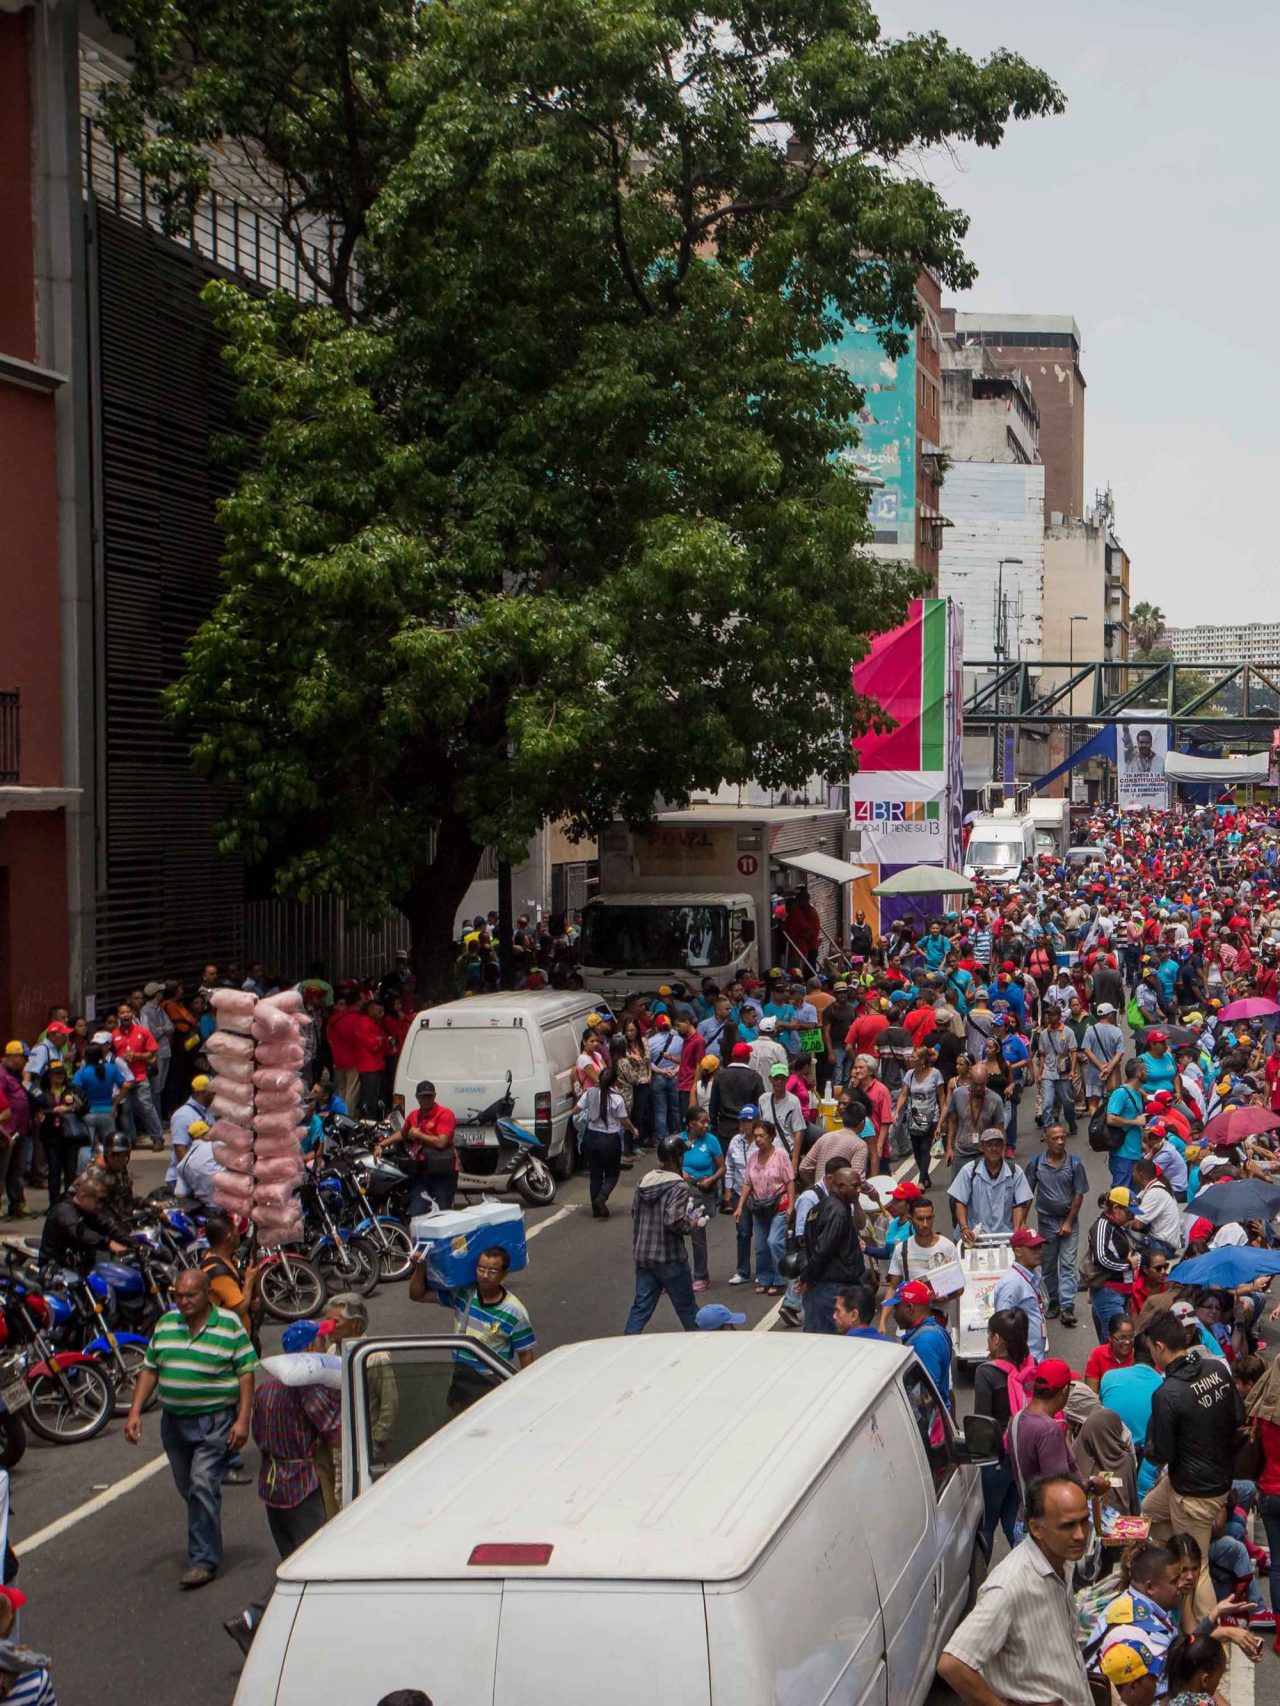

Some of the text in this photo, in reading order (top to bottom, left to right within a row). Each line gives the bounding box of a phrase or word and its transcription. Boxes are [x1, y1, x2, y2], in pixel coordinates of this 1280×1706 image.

[855, 801, 940, 821] 4BRIL
[854, 821, 940, 835] CADA 11 TIENE SU 13
[741, 857, 754, 872] 11
[1190, 1371, 1223, 1395] THINK
